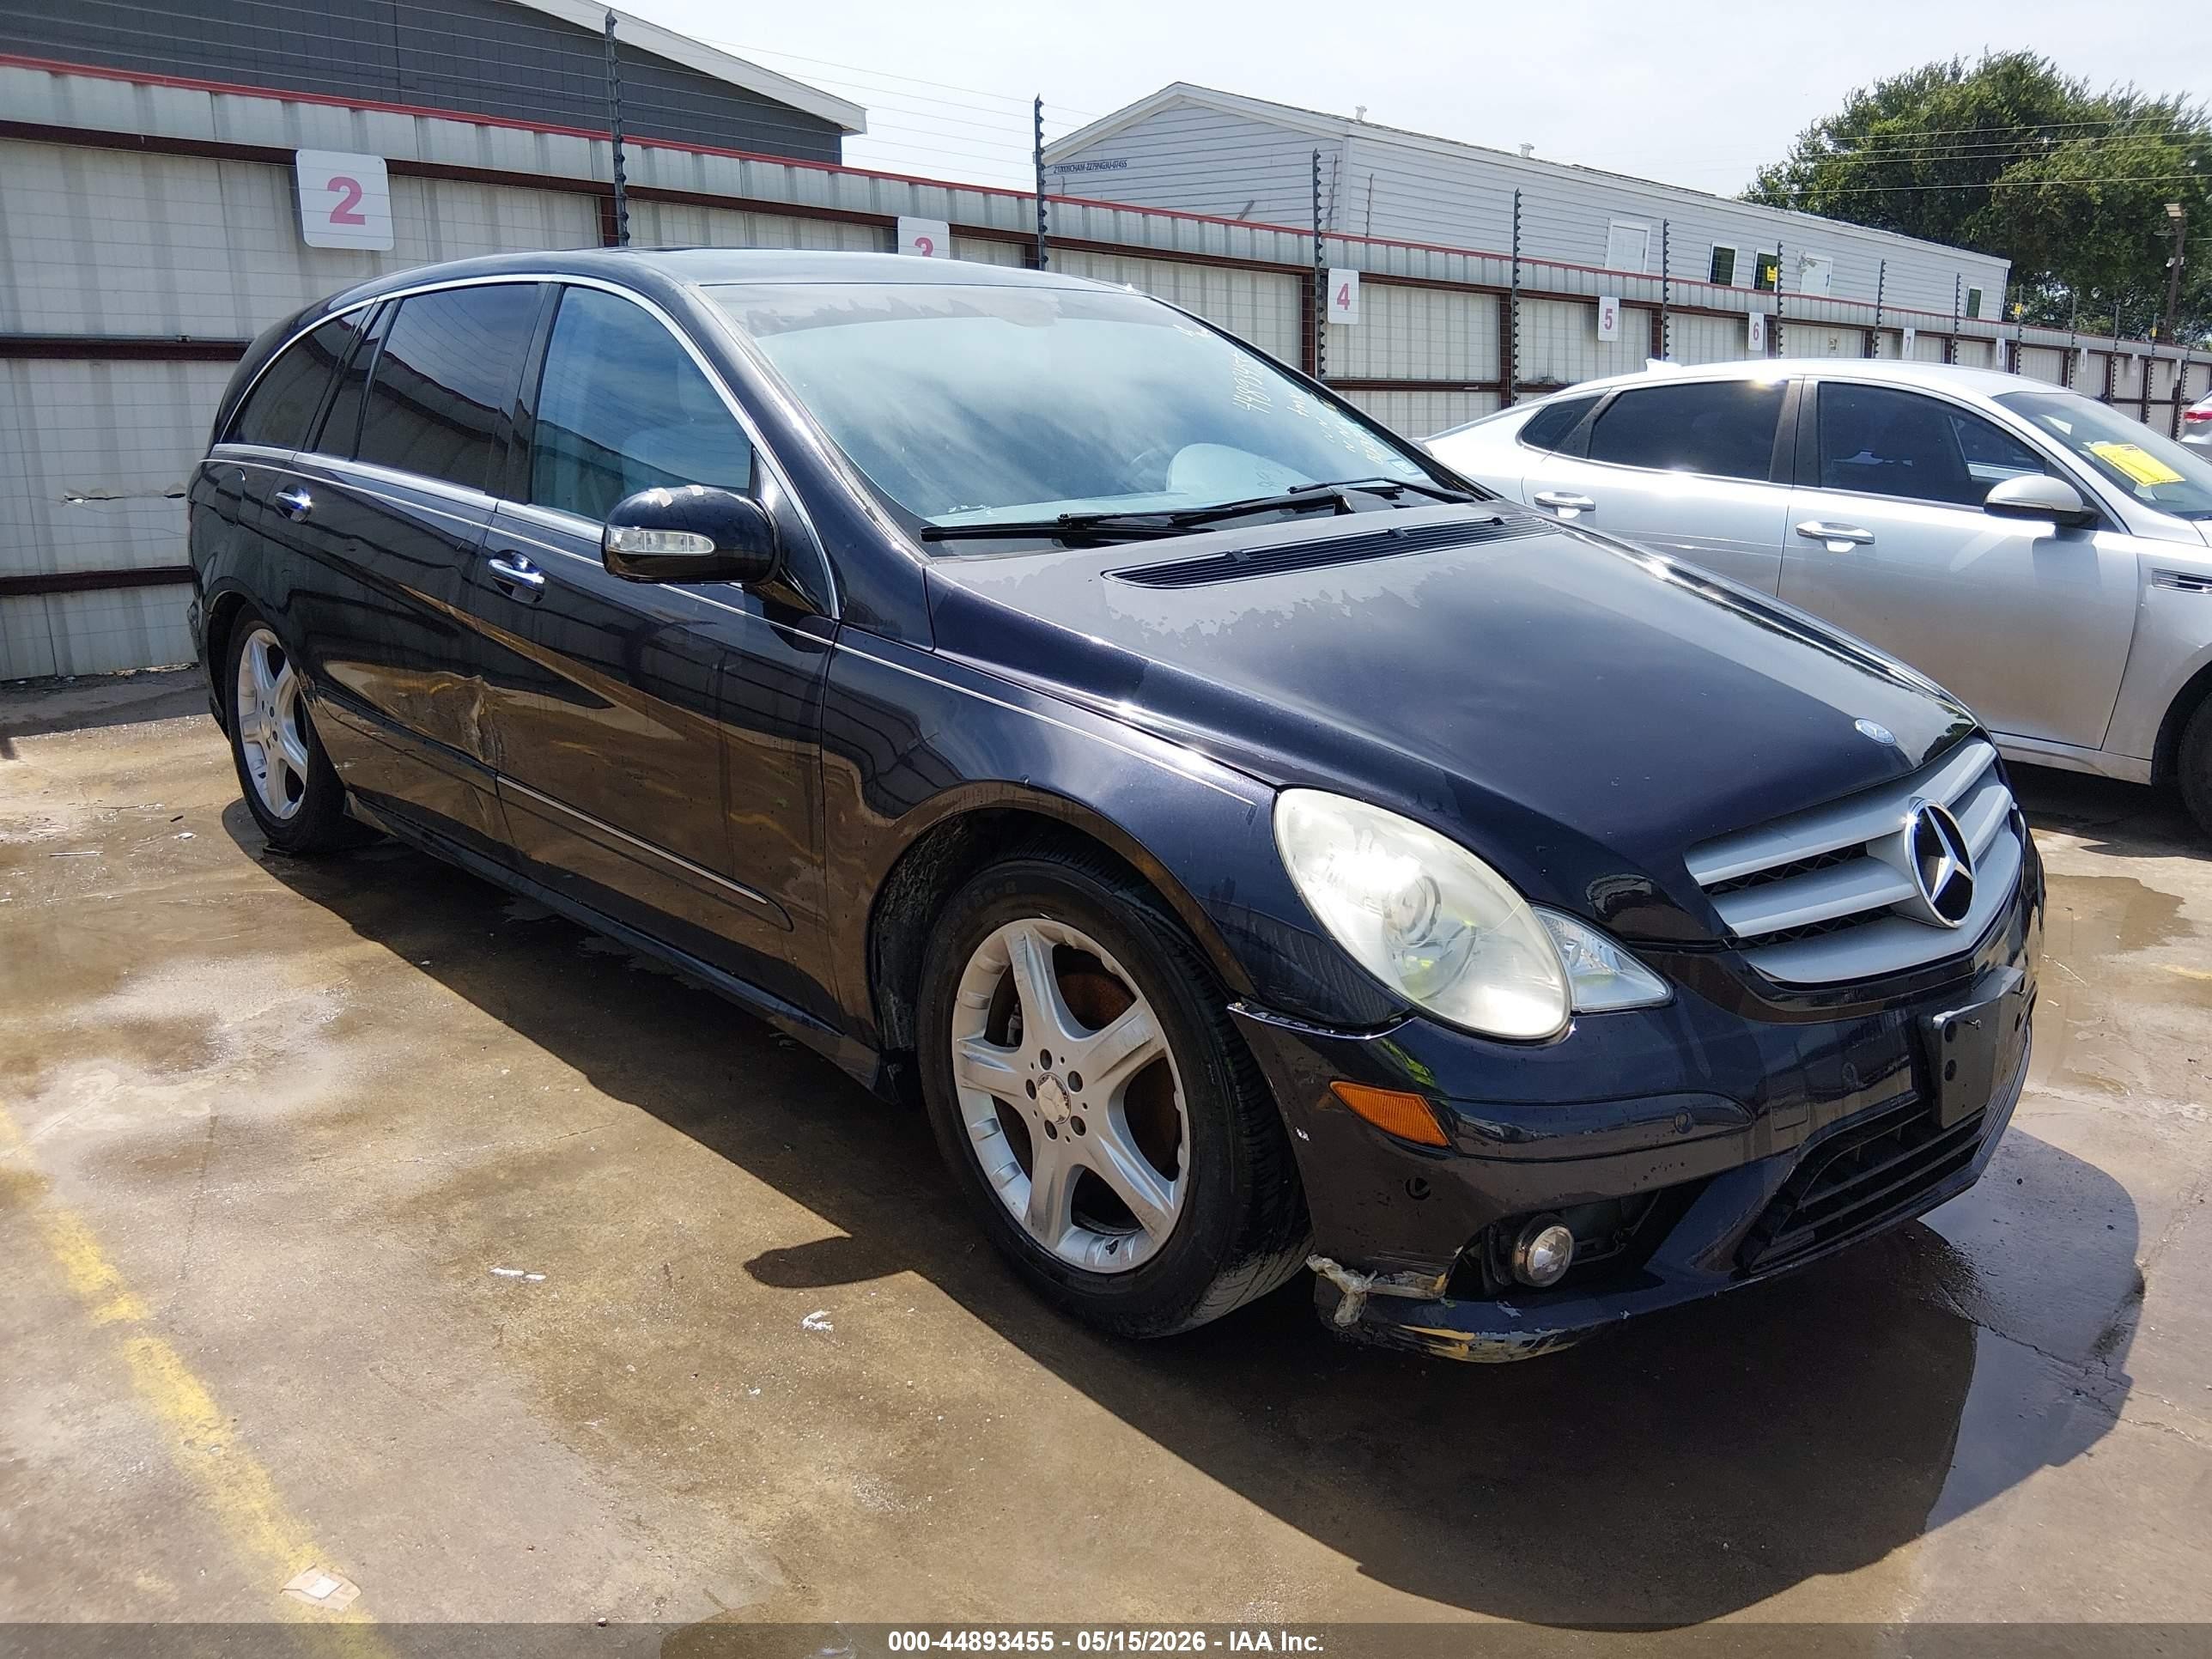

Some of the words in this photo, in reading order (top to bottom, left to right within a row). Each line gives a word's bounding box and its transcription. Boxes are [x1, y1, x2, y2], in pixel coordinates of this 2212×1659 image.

[326, 176, 367, 226] 2
[1336, 283, 1352, 311] 4
[1603, 308, 1613, 331] 5
[1753, 321, 1760, 341] 6
[1905, 336, 1912, 352] 7
[1997, 344, 2003, 359] 8
